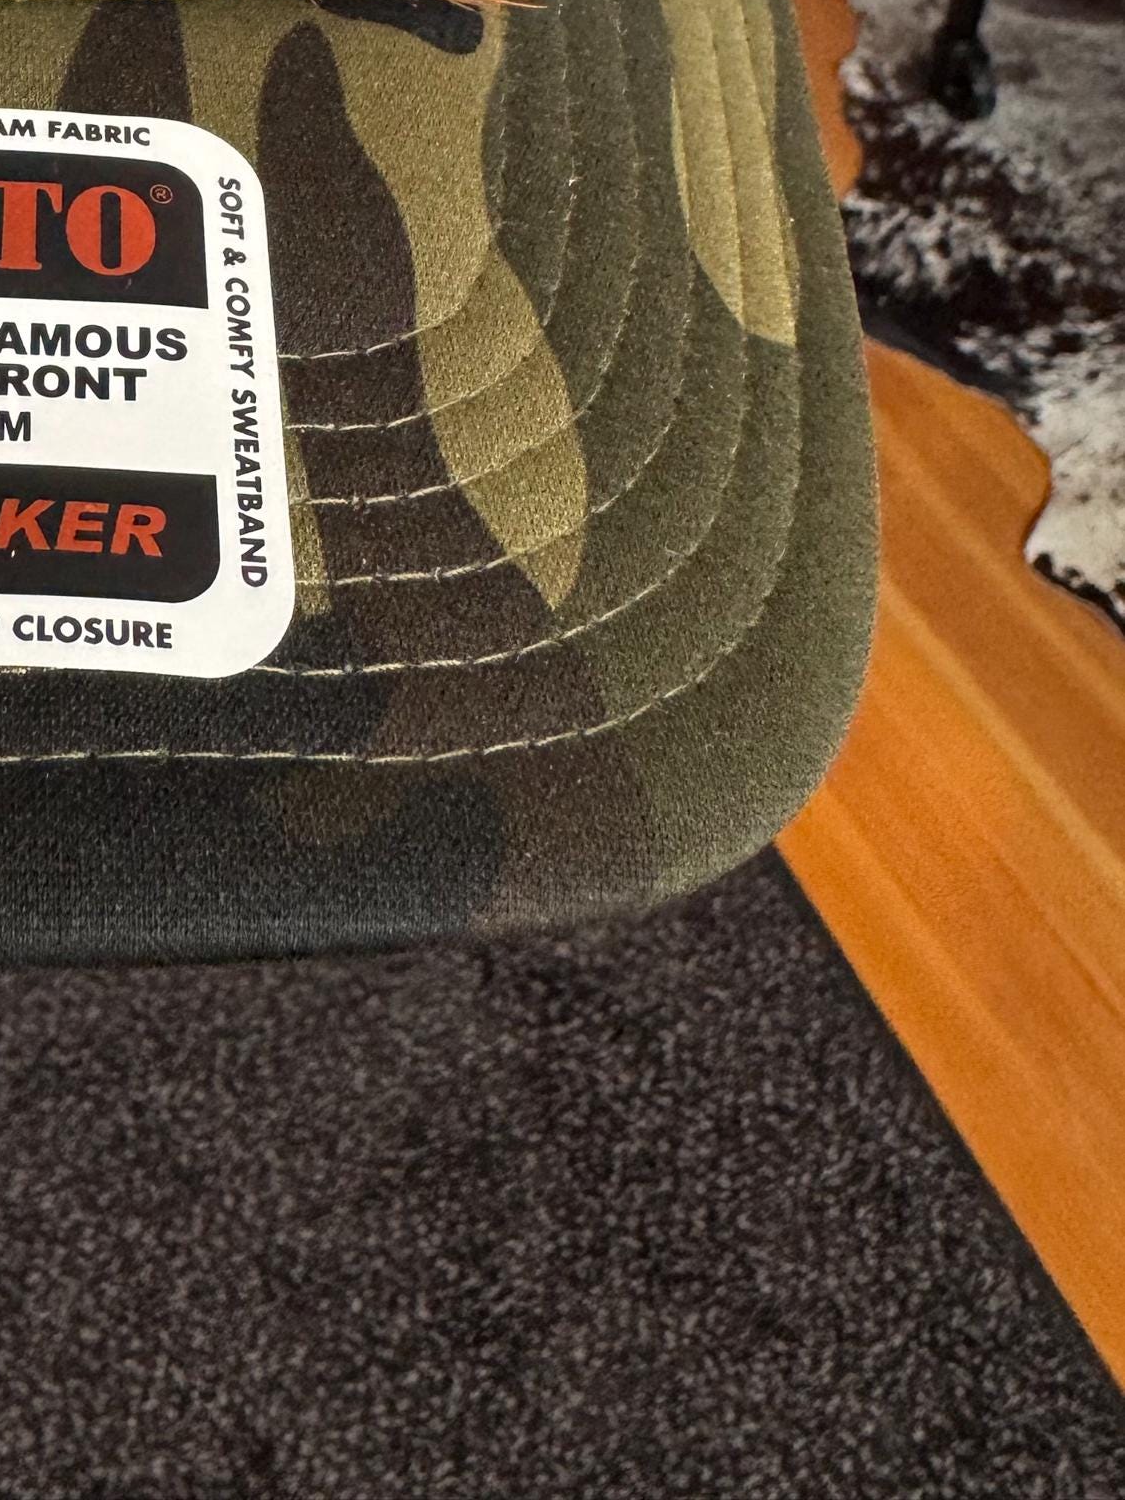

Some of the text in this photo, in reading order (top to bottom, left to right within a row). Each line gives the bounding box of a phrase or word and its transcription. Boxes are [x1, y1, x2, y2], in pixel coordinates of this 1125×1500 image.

[48, 120, 150, 147] FABRIC
[218, 176, 268, 588] SOFT & COMFY SWEATBAND
[12, 614, 174, 649] CLOSURE
